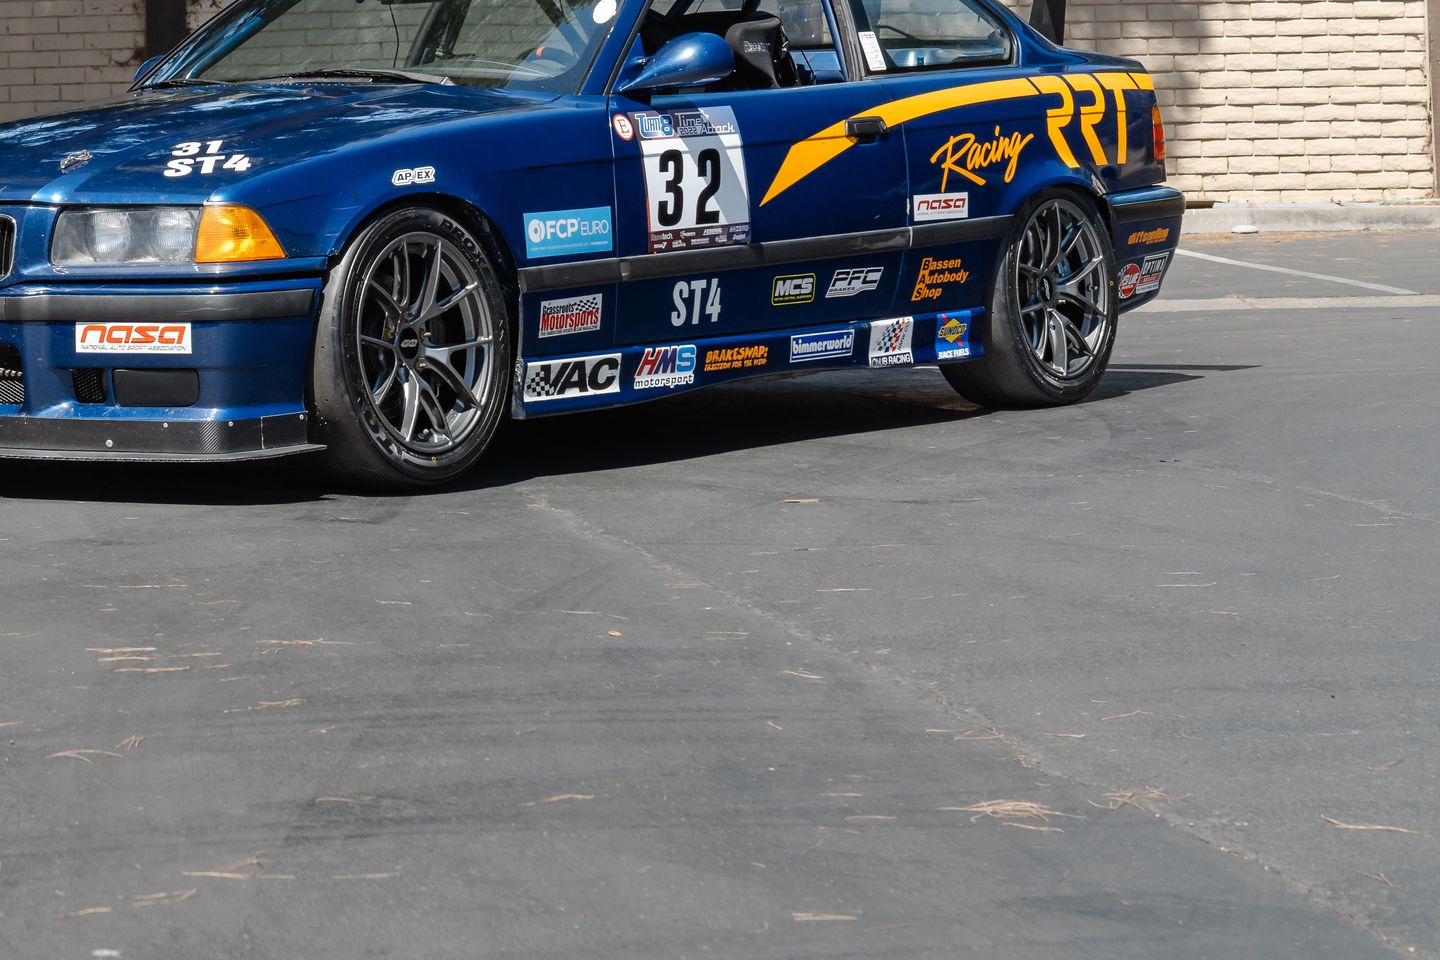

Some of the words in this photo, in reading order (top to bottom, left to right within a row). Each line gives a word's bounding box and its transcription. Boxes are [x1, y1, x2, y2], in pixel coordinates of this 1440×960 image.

[617, 119, 630, 134] E
[700, 123, 736, 134] Attack
[1028, 73, 1140, 169] RRT
[172, 140, 223, 157] 31
[164, 154, 252, 177] ST4
[930, 125, 1034, 193] Racing
[658, 148, 720, 227] 32
[546, 218, 579, 239] FCP
[580, 220, 609, 236] EURO
[922, 258, 962, 271] Bassen
[831, 267, 883, 288] PFC
[918, 269, 970, 285] Autobody
[774, 277, 814, 297] MCS
[913, 286, 943, 300] Shop
[542, 303, 575, 316] Grassroots
[671, 278, 721, 327] ST4
[540, 309, 600, 332] Motorsports
[80, 325, 187, 344] nasa
[939, 324, 968, 337] SUNOCO
[792, 335, 853, 355] bimmerworld
[937, 350, 953, 360] RACE
[953, 347, 970, 357] FUELS
[636, 345, 696, 377] HMS
[888, 353, 911, 365] RACING
[540, 358, 620, 396] VAC
[635, 374, 694, 389] motorsport
